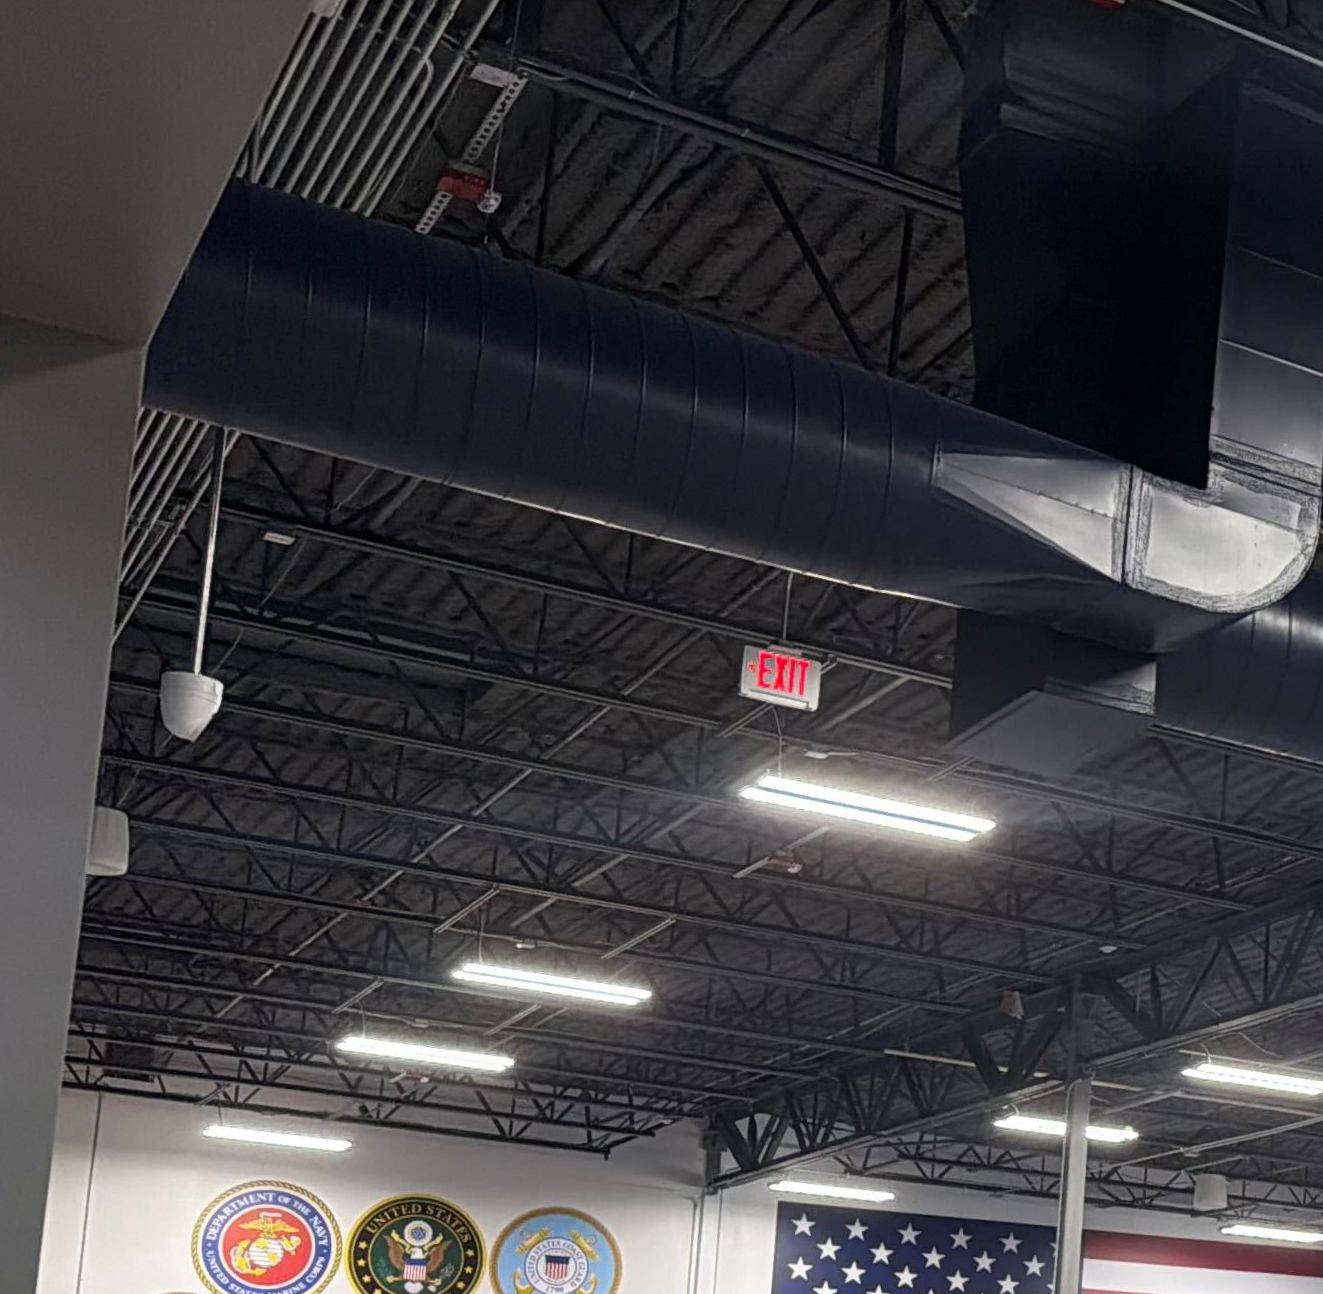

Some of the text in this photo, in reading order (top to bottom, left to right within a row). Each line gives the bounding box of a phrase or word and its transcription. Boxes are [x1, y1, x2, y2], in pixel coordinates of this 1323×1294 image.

[757, 651, 809, 696] EXIT
[206, 1192, 329, 1246] DEPARTMENT OF THE NAVY
[366, 1203, 472, 1243] UNITED STATES
[205, 1250, 230, 1285] UNITED
[305, 1256, 326, 1283] CORPS
